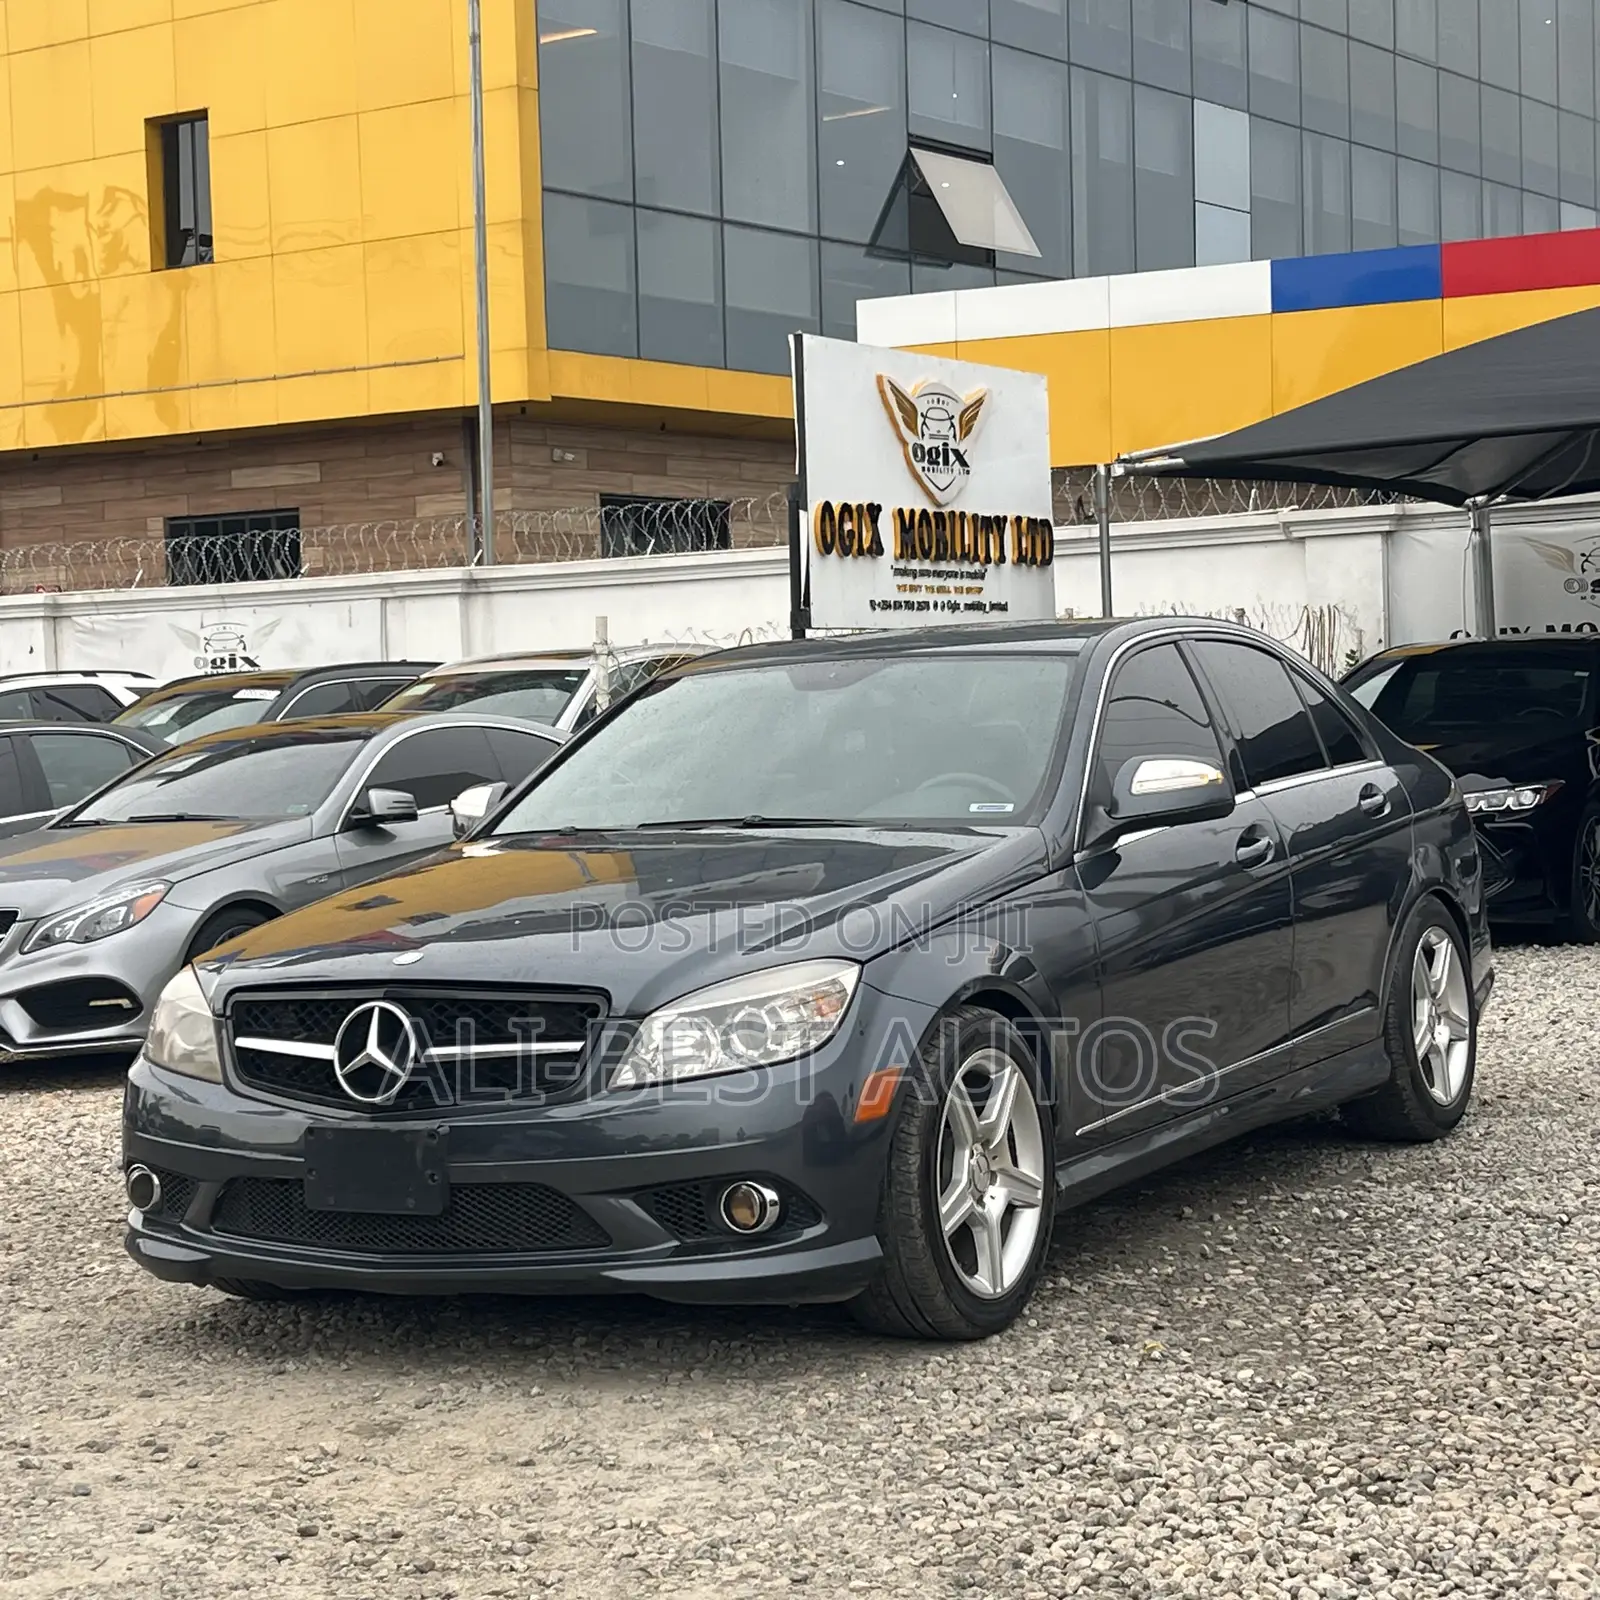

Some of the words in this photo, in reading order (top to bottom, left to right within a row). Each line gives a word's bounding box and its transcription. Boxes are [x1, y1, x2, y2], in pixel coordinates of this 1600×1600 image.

[814, 500, 884, 557] OGIX
[892, 507, 1007, 565] MOBILITY
[1009, 515, 1054, 566] LTD
